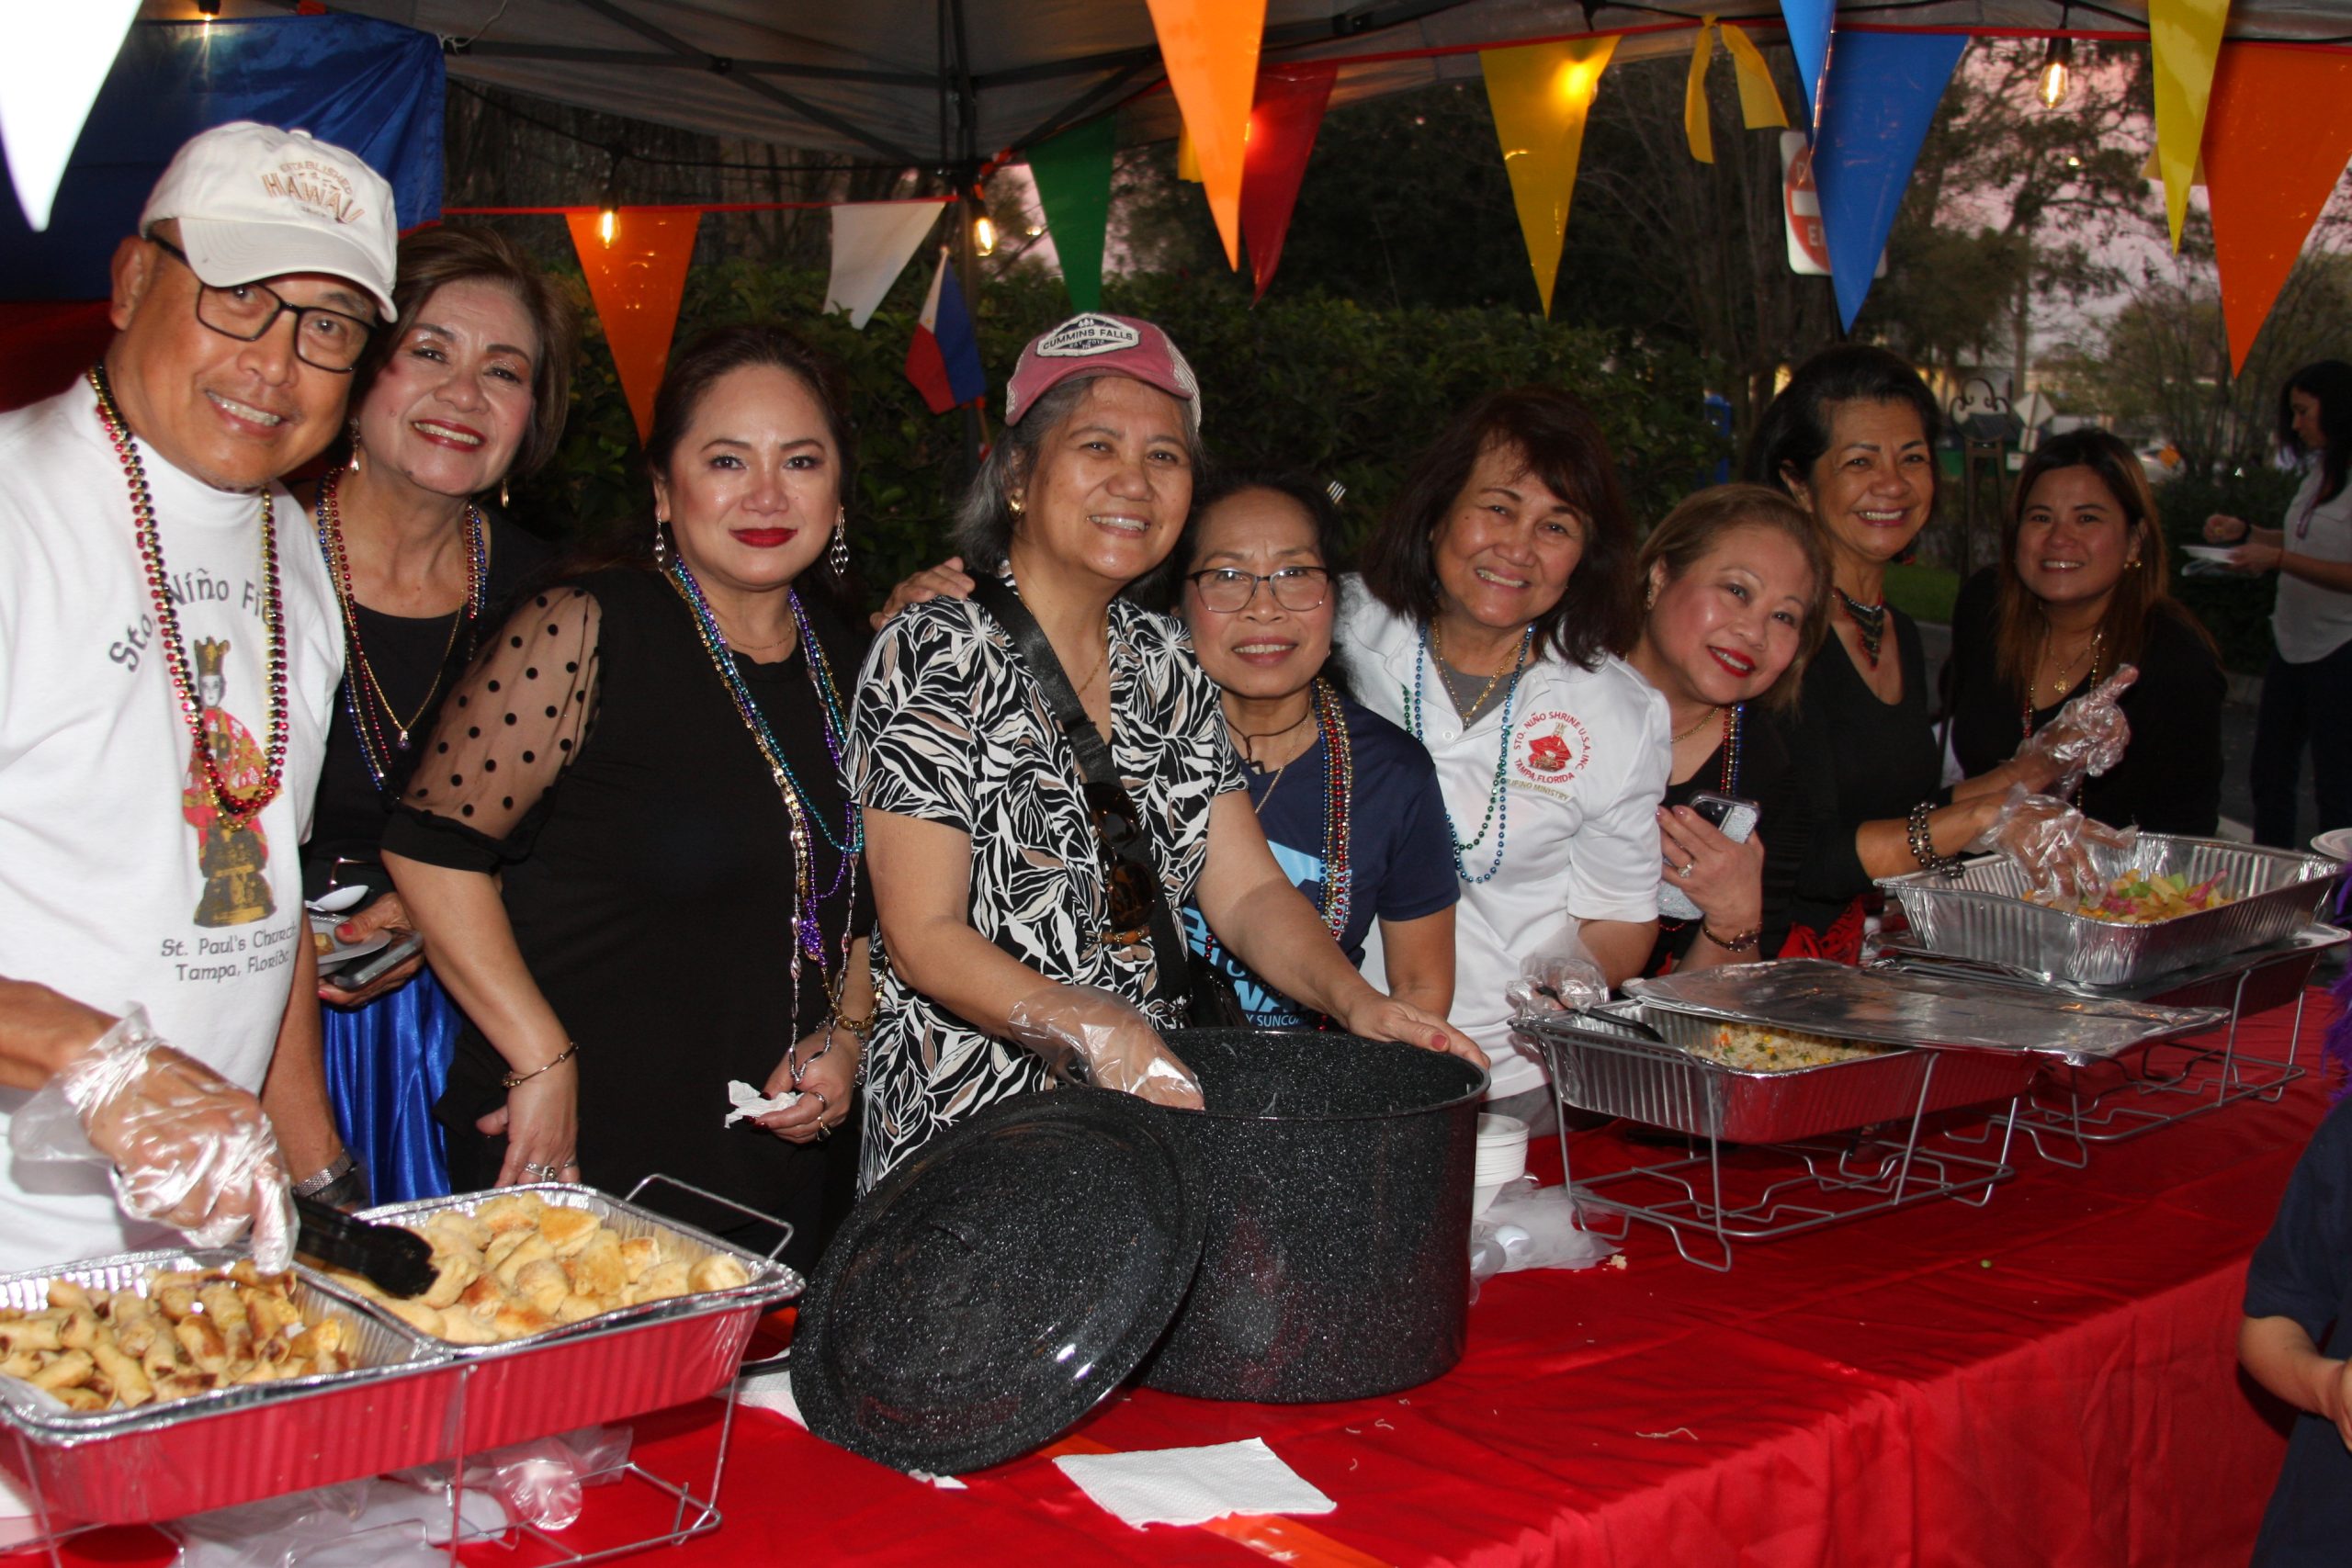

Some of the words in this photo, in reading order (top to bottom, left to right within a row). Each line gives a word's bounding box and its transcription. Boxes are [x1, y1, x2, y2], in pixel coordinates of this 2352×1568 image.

[1043, 329, 1095, 350] CUMMINS
[1100, 329, 1133, 341] FALLS
[109, 613, 156, 672] Sto.
[1514, 731, 1526, 750] STO.
[1523, 712, 1546, 730] NIÑO
[1548, 711, 1580, 729] SHRINE
[1537, 772, 1575, 784] FLORIDA
[1533, 784, 1570, 801] MINISTRY
[161, 938, 188, 957] St.
[198, 935, 246, 955] Paul's
[175, 964, 241, 983] Tampa,
